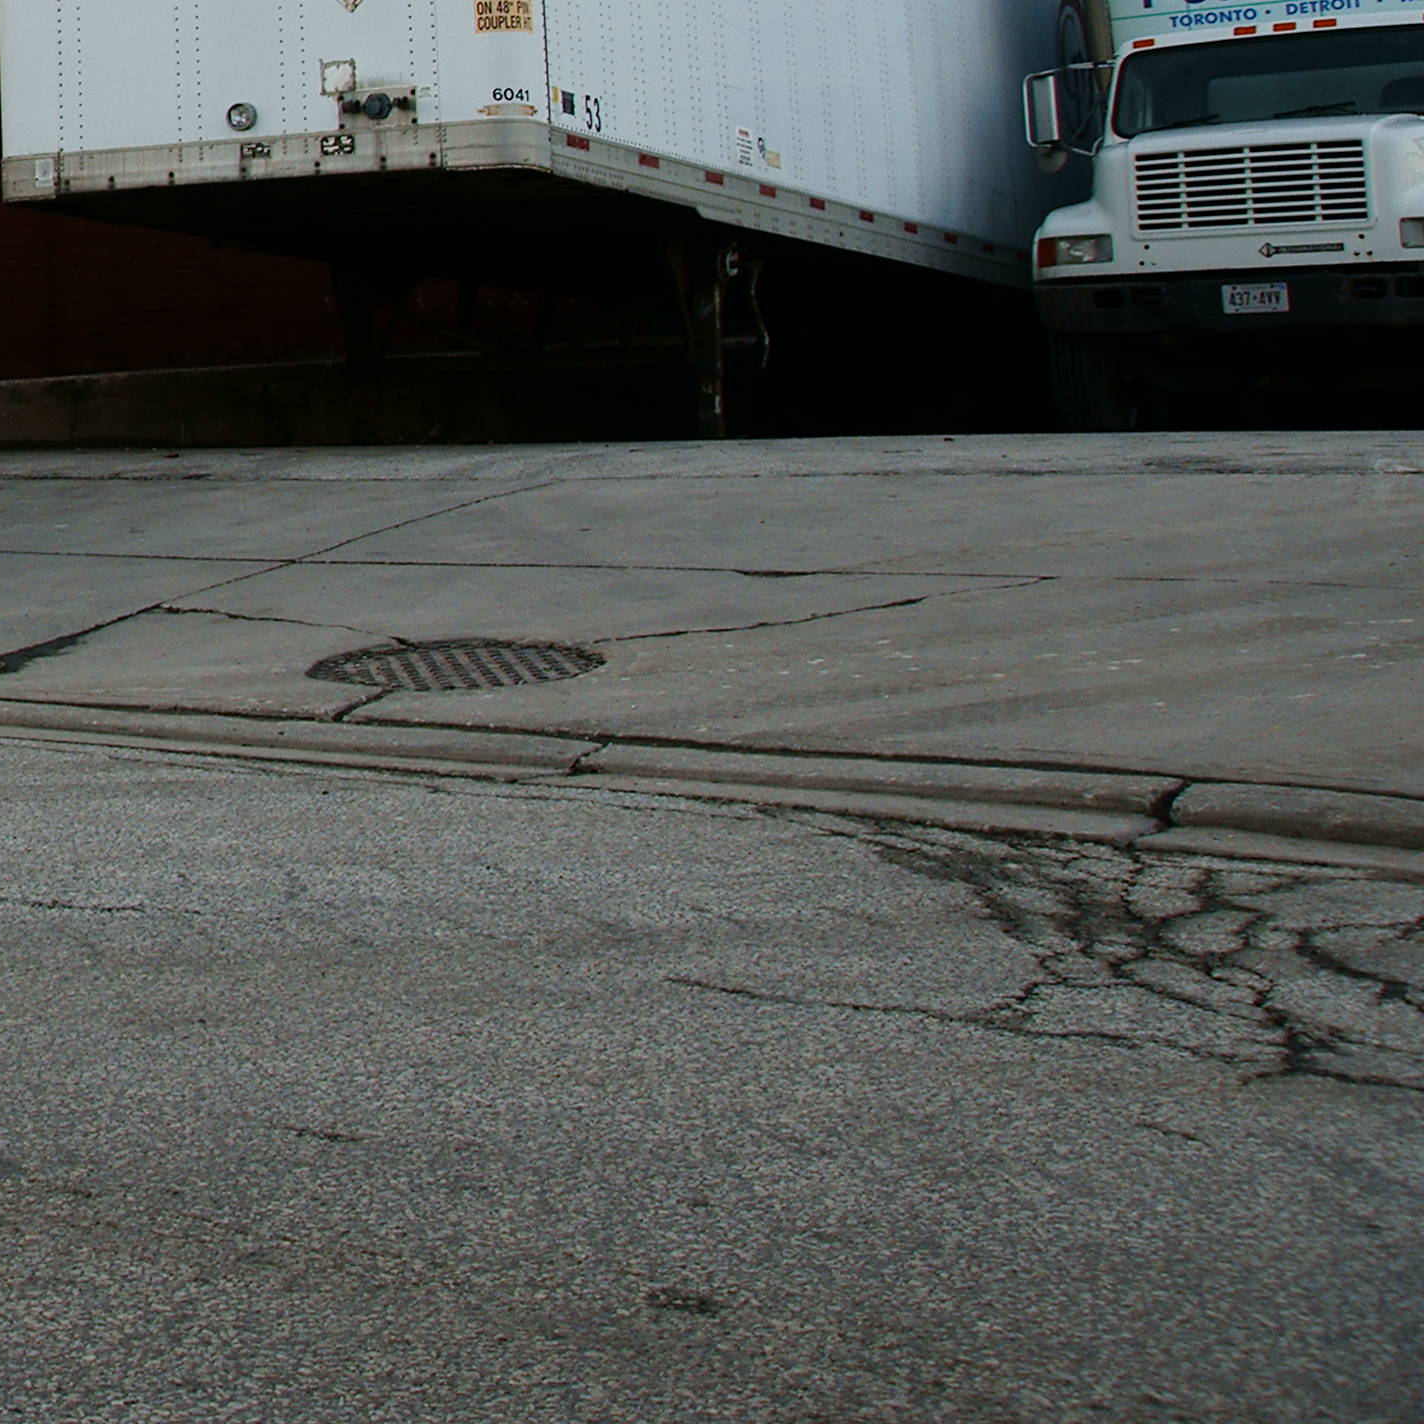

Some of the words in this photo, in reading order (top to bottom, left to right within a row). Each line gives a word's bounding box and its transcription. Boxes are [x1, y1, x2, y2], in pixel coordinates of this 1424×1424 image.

[476, 1, 492, 15] ON
[477, 16, 521, 31] COUPLER
[1170, 8, 1257, 28] TORONTO
[492, 87, 530, 102] 6041
